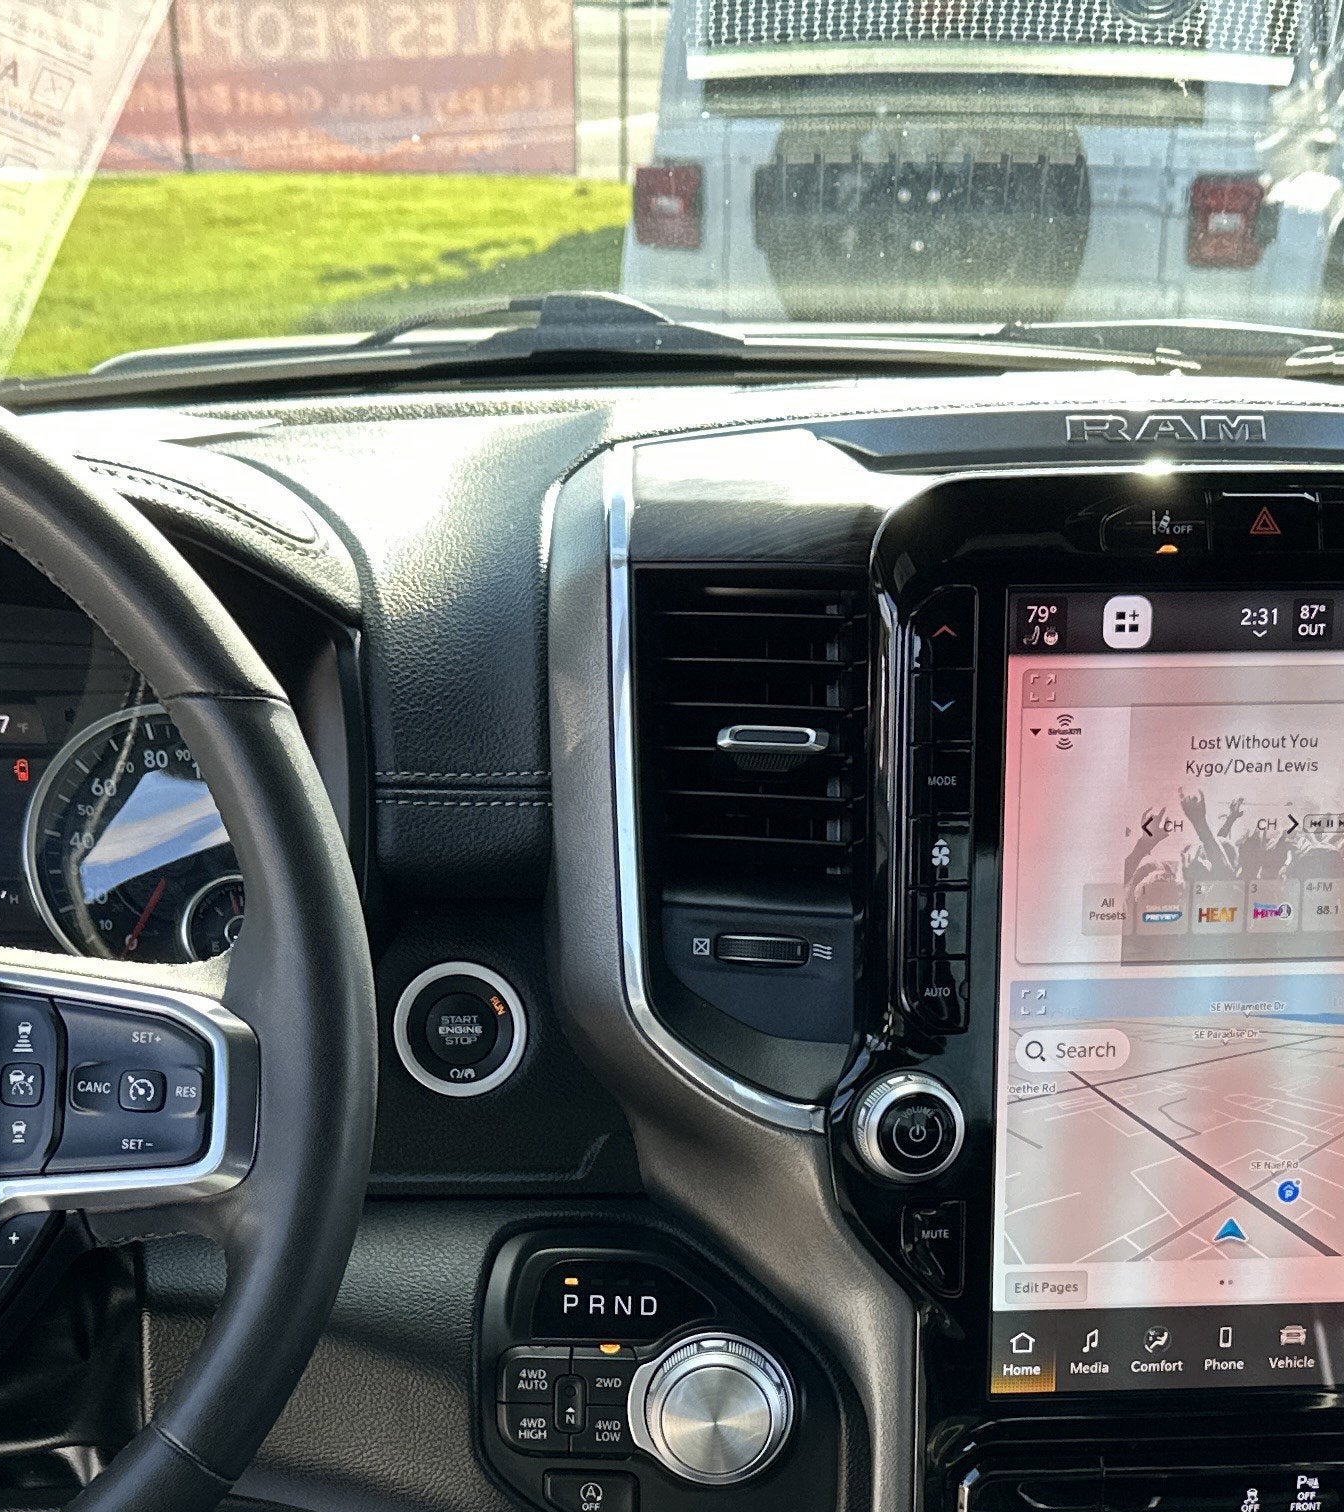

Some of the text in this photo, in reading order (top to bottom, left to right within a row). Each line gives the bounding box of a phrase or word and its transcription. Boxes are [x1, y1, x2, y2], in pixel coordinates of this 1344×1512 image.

[1065, 415, 1267, 441] RAM
[1172, 525, 1193, 534] OFF
[1240, 607, 1279, 626] 2:31
[1297, 623, 1326, 637] OUT
[1190, 733, 1319, 751] Lost Without You
[143, 750, 169, 769] 80
[1185, 757, 1319, 778] Kygo/Dean Lewis
[927, 775, 958, 786] MODE
[91, 779, 117, 797] 60
[77, 803, 96, 817] 50
[1163, 819, 1184, 833] CH
[1256, 818, 1278, 831] CH
[69, 831, 95, 850] 40
[1100, 897, 1116, 910] All
[1316, 904, 1340, 915] 88.1
[1088, 909, 1127, 922] Presets
[1197, 906, 1238, 924] HEAT
[98, 918, 114, 931] 10
[924, 987, 951, 998] AUTO
[489, 994, 507, 1017] RUN
[1210, 1003, 1222, 1013] SE
[1273, 1001, 1286, 1011] Dr
[440, 1015, 479, 1024] START
[438, 1025, 483, 1034] ENGINE
[1193, 1030, 1205, 1039] SE
[444, 1036, 478, 1046] STOP
[1055, 1041, 1117, 1060] Search
[76, 1080, 112, 1095] CANC
[174, 1085, 197, 1099] RES
[1008, 1082, 1056, 1095] oethe Rd
[902, 1105, 936, 1120] VOLUME
[1250, 1161, 1261, 1170] SE
[1286, 1160, 1299, 1170] Rd
[921, 1229, 951, 1240] MUTE
[1014, 1281, 1080, 1296] Edit Pages
[563, 1293, 658, 1317] P R N D
[1069, 1361, 1111, 1375] Media
[1130, 1360, 1185, 1374] Comfort
[1204, 1358, 1245, 1371] Phone
[1268, 1355, 1316, 1369] Vehicle
[519, 1369, 547, 1379] 4WD
[1002, 1363, 1042, 1377] Home
[517, 1380, 548, 1391] AUTO
[595, 1378, 623, 1389] 2WD
[519, 1418, 546, 1429] 4WD
[565, 1414, 576, 1425] N
[594, 1420, 621, 1431] 4WD
[518, 1429, 548, 1440] HIGH
[595, 1431, 621, 1442] LOW
[1297, 1491, 1317, 1501] OFF
[581, 1502, 600, 1512] OFF
[1289, 1501, 1322, 1512] FRONT
